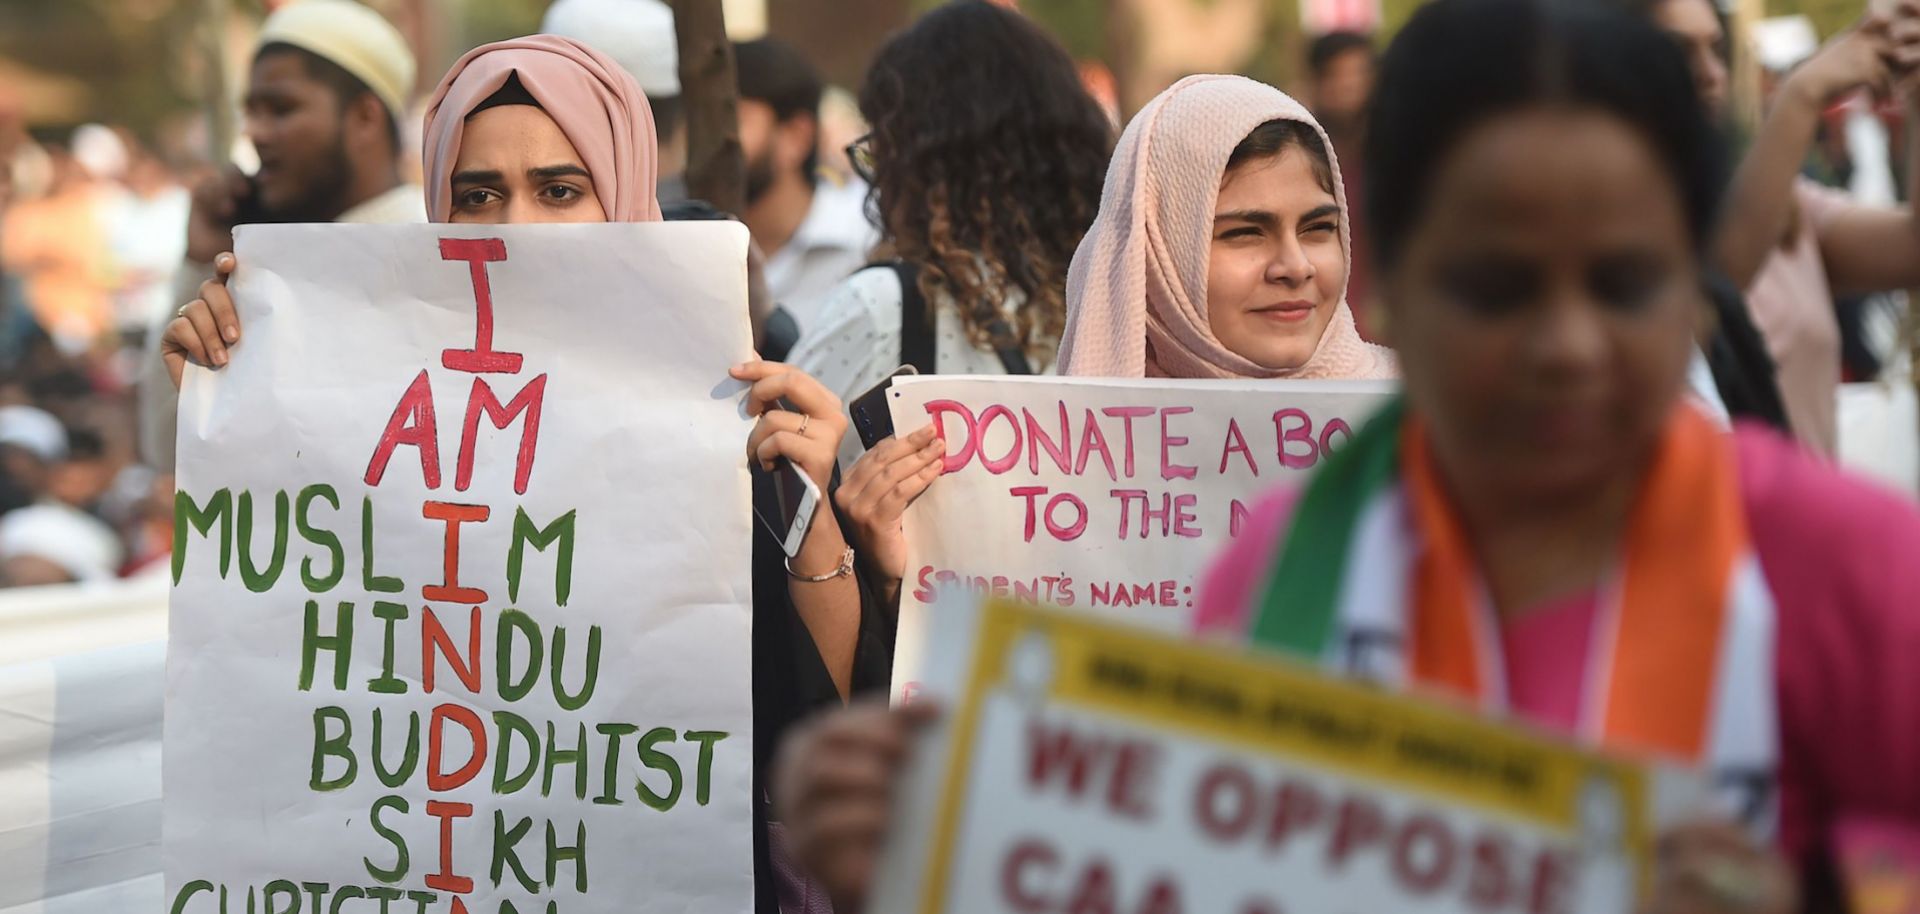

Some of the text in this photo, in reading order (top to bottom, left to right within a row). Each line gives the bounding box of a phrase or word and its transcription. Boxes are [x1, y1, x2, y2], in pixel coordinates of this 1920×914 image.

[438, 238, 523, 374] I
[364, 369, 547, 495] AM
[924, 399, 1198, 481] DONATE
[1219, 417, 1259, 477] A
[172, 484, 576, 606] MUSLIM
[1010, 486, 1088, 543] TO
[1110, 489, 1202, 540] THE
[1090, 579, 1193, 608] NAME:
[299, 599, 600, 710] HINDU
[309, 703, 730, 812] BUDDHIST
[1026, 716, 1160, 822] WE
[364, 795, 586, 894] SIKH
